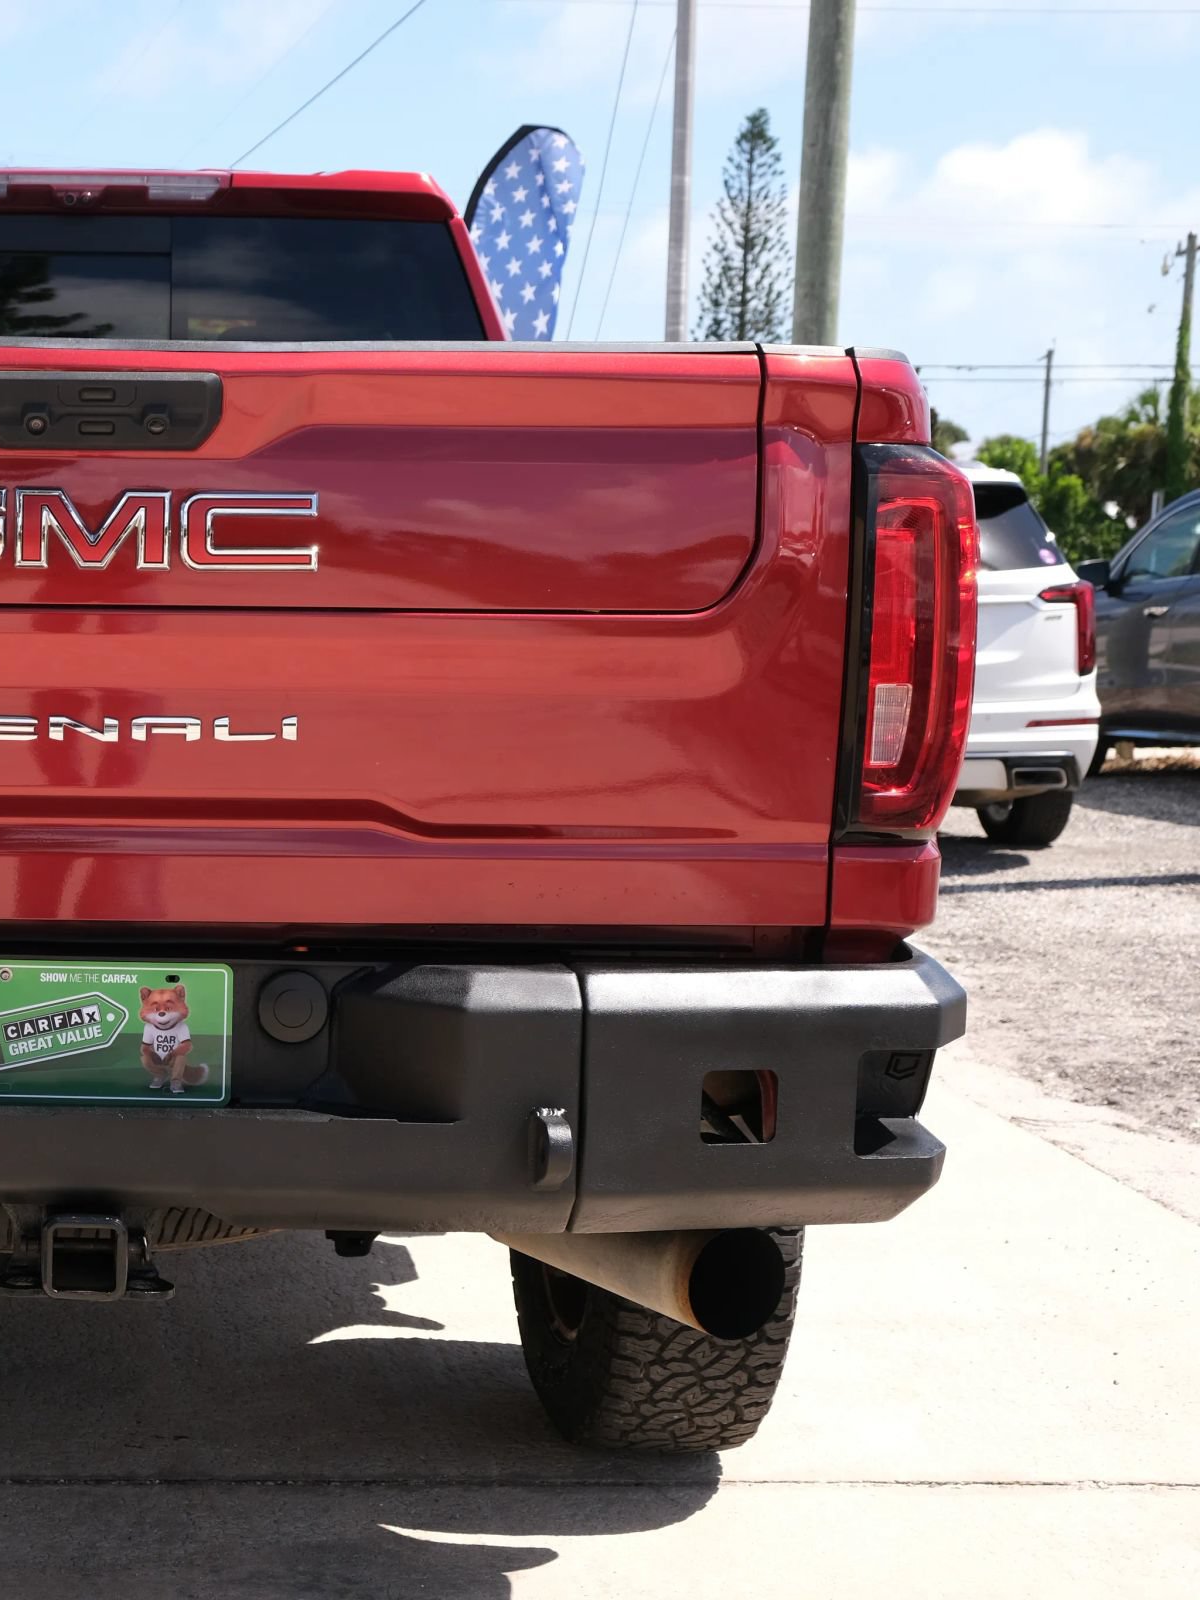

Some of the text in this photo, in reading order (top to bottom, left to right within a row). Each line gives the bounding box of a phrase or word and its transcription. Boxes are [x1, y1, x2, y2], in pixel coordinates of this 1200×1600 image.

[40, 972, 138, 984] SHOW ME THE CARFAX
[2, 1003, 101, 1042] CARFAX
[8, 1025, 103, 1056] GREAT VALUE
[156, 1035, 176, 1044] CAR
[156, 1044, 174, 1052] FOX
